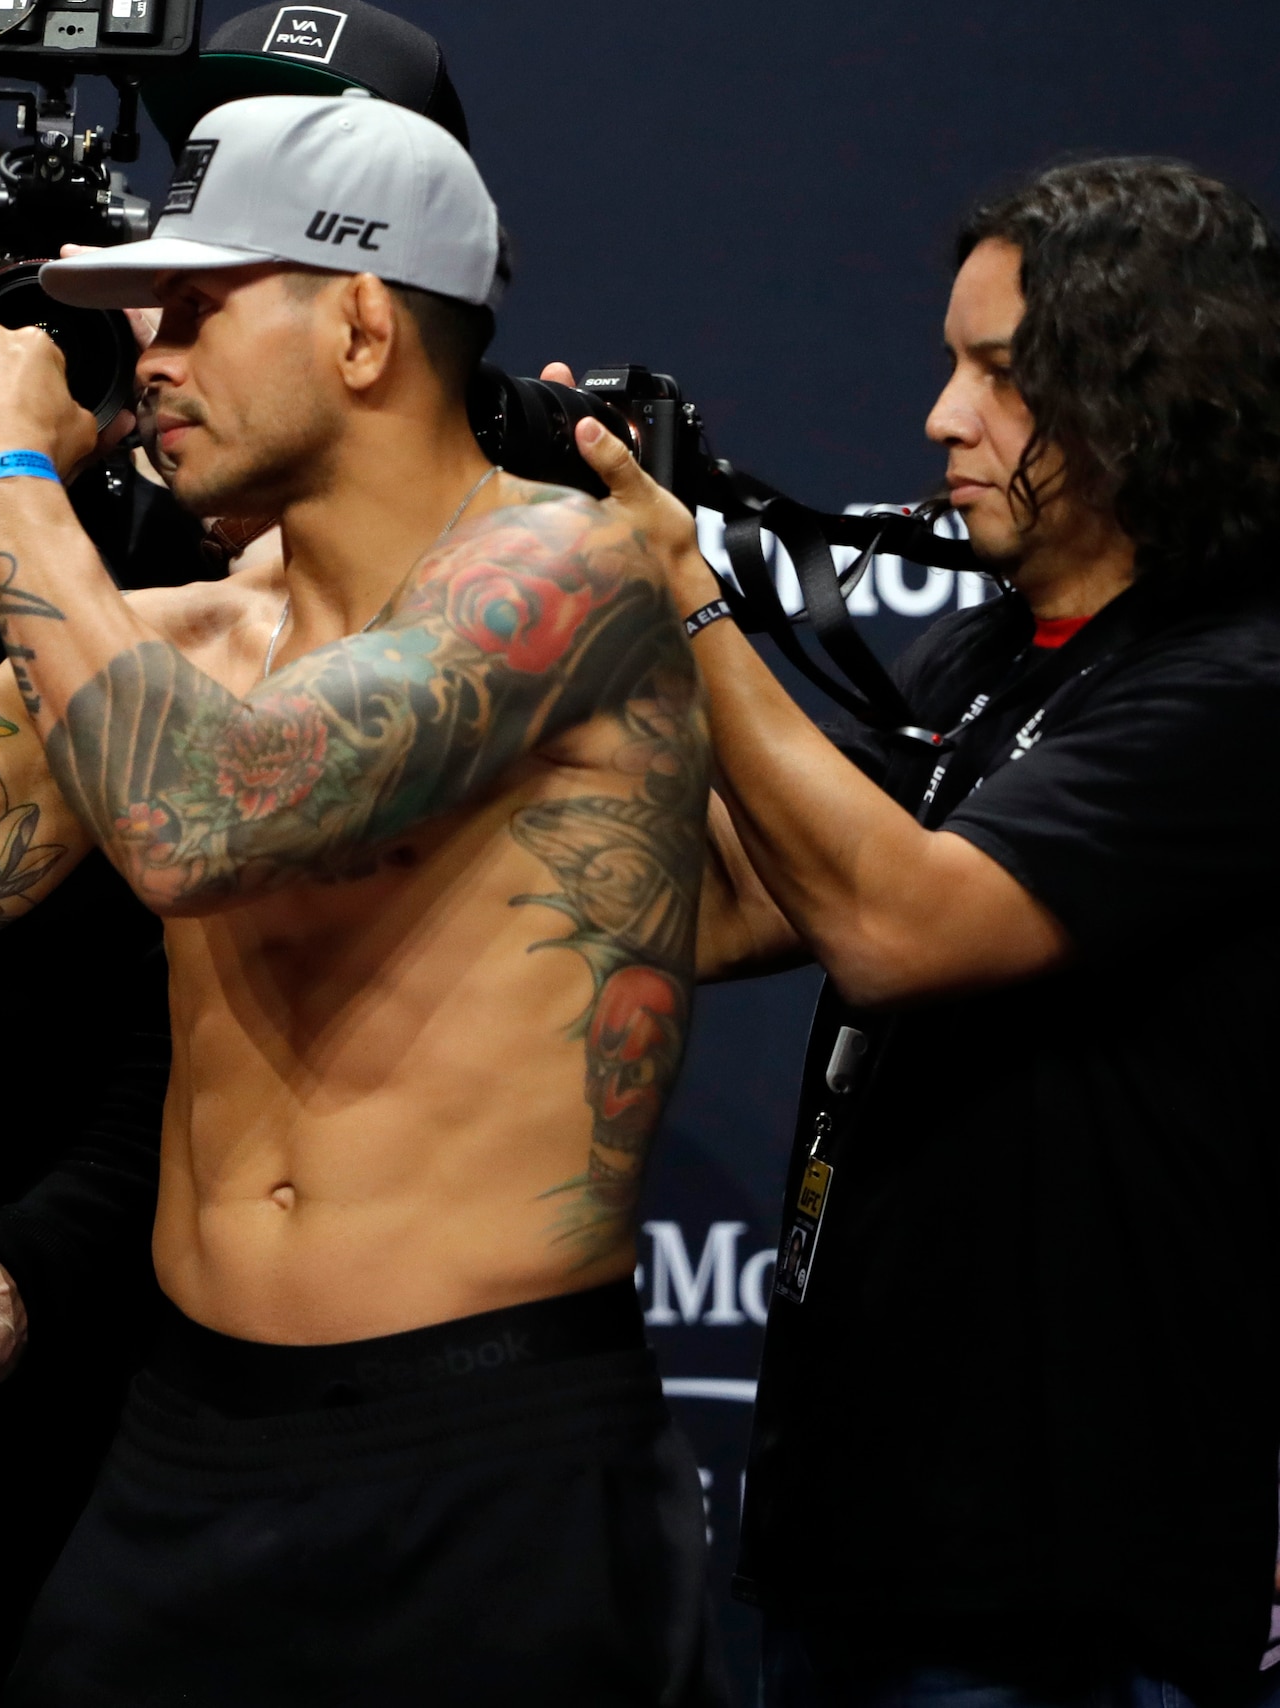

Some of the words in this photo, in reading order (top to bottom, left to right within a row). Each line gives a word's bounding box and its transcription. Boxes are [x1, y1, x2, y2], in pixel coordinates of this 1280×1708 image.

[291, 19, 318, 33] VA
[276, 33, 323, 48] RVCA
[305, 210, 389, 251] UFC
[585, 378, 620, 386] SONY
[923, 765, 946, 804] UFC
[800, 1186, 821, 1213] UFC
